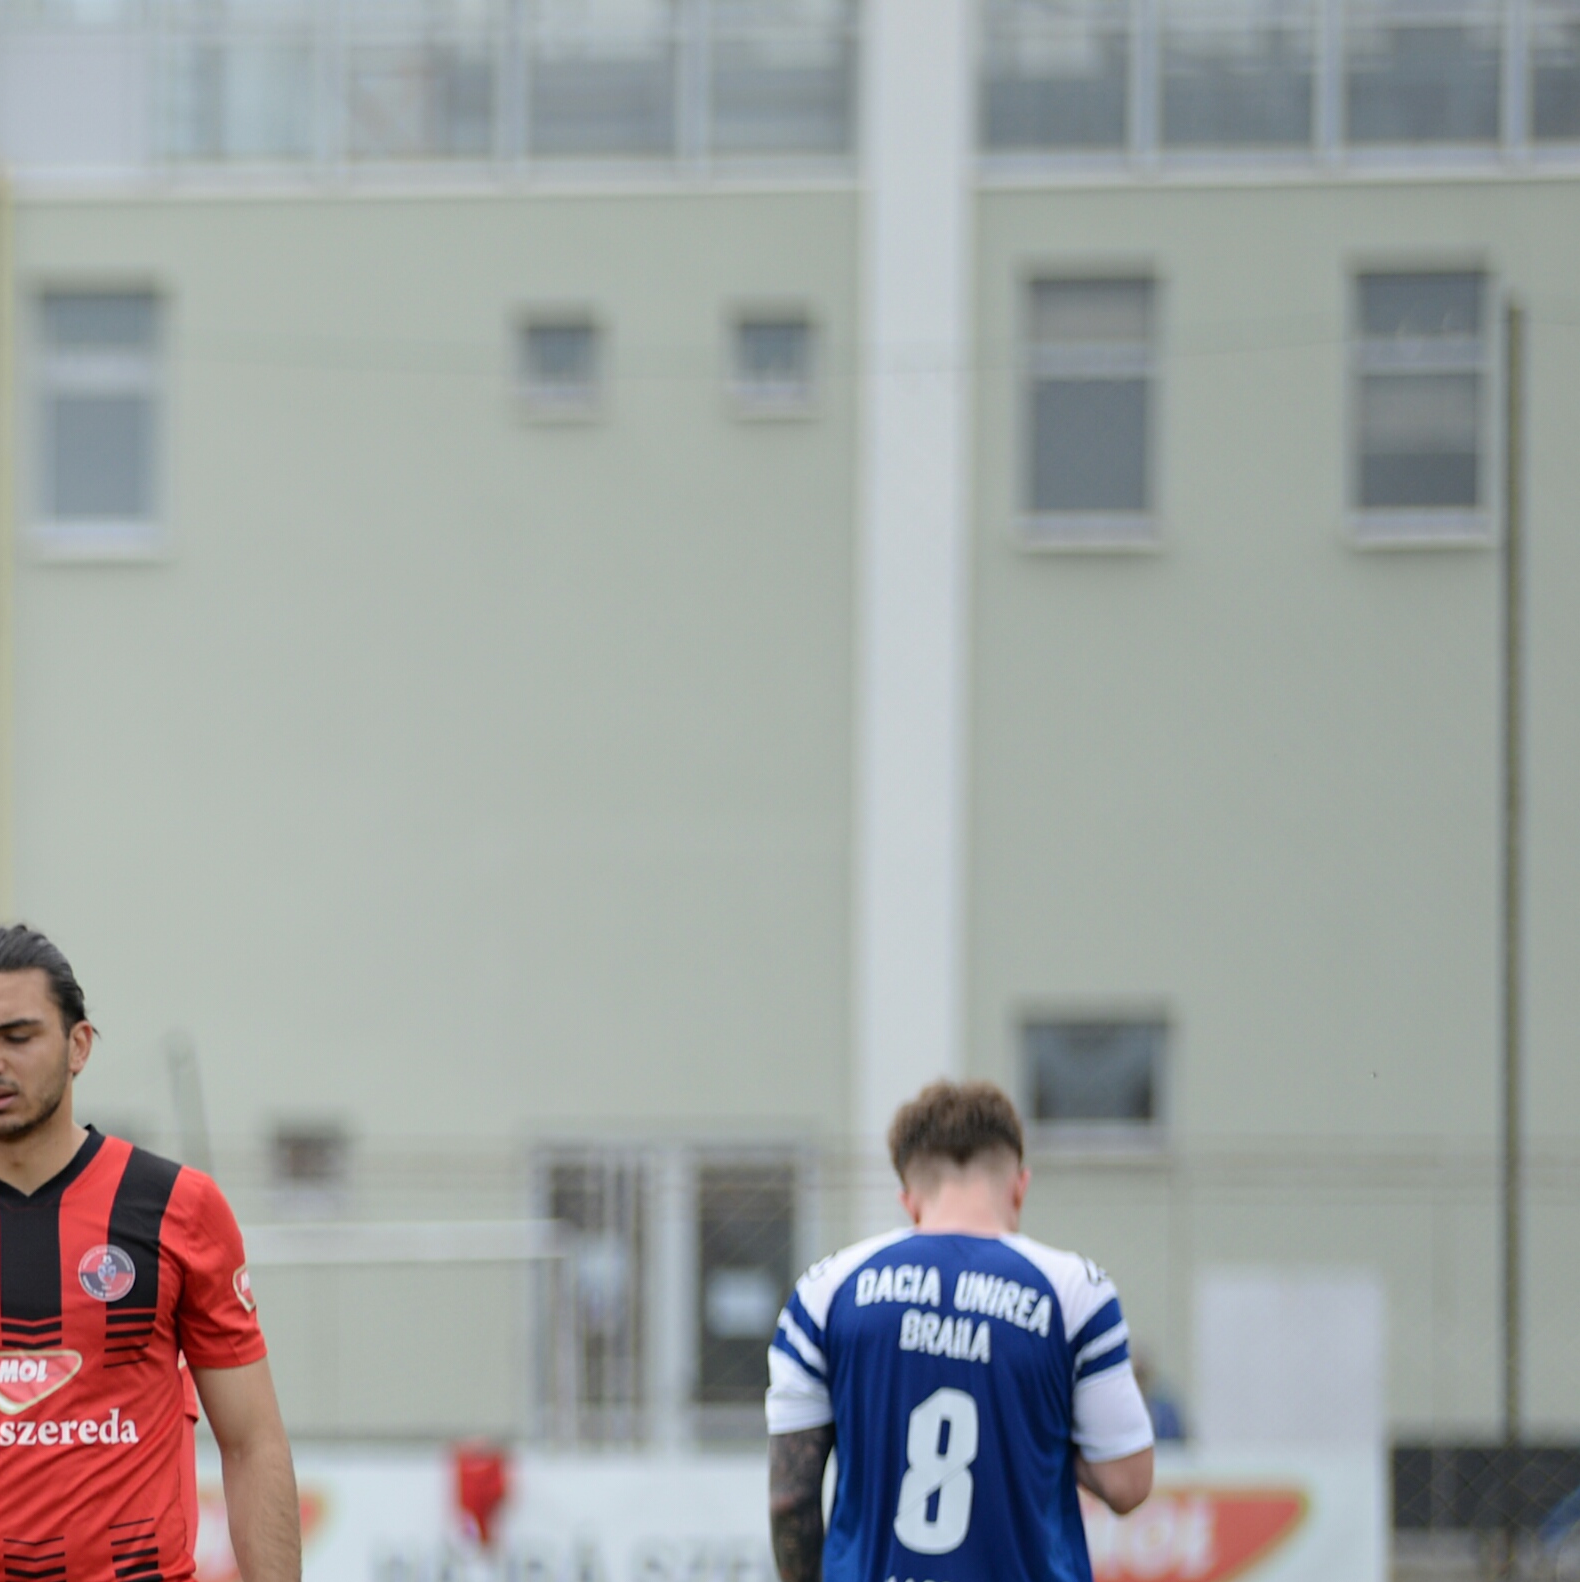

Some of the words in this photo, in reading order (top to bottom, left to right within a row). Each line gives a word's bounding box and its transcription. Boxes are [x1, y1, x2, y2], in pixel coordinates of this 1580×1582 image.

[854, 1263, 941, 1308] DACIA
[953, 1270, 1052, 1338] UNIREA
[899, 1307, 991, 1364] BRAILA
[893, 1386, 979, 1555] 8
